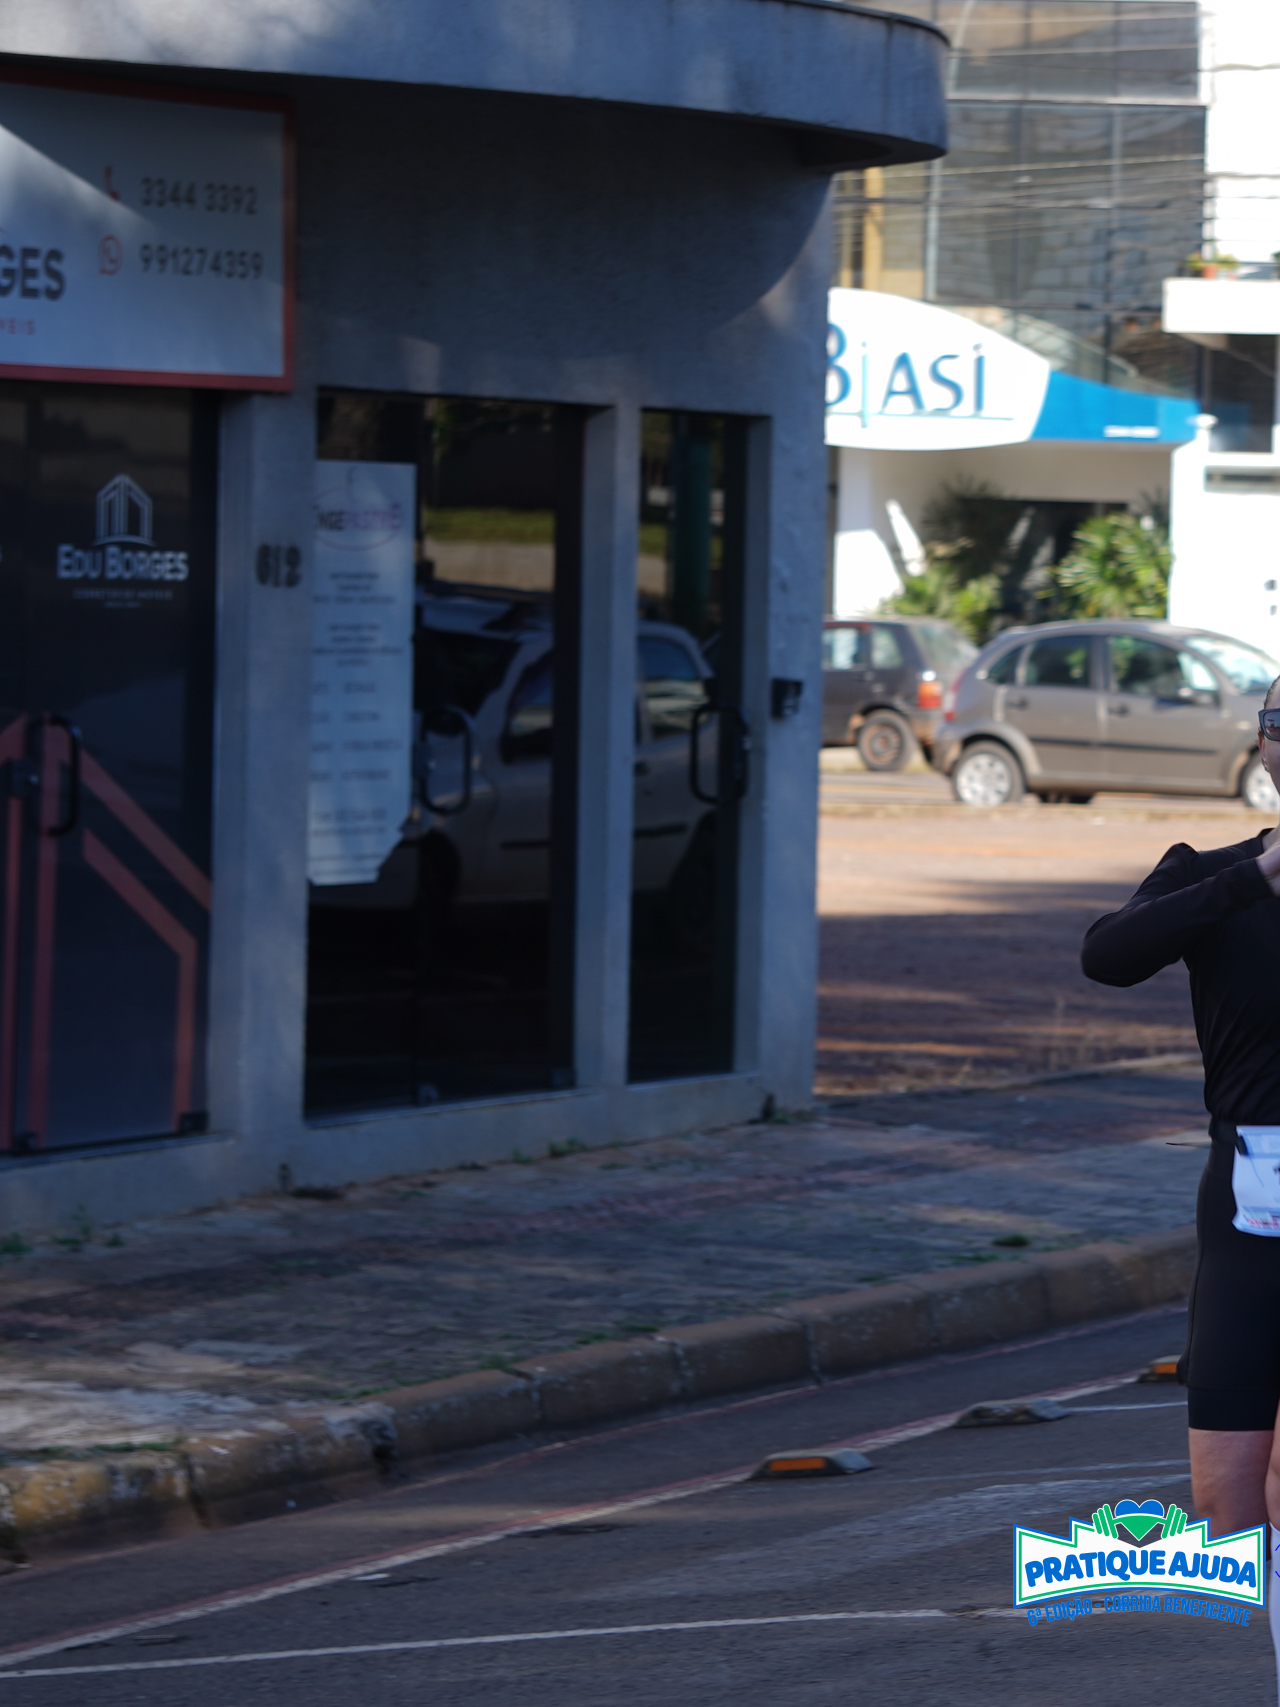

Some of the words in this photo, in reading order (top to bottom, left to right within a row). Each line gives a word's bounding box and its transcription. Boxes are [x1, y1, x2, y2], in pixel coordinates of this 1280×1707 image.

[141, 177, 197, 208] 3344
[204, 183, 259, 215] 3392
[140, 243, 264, 280] 991274359
